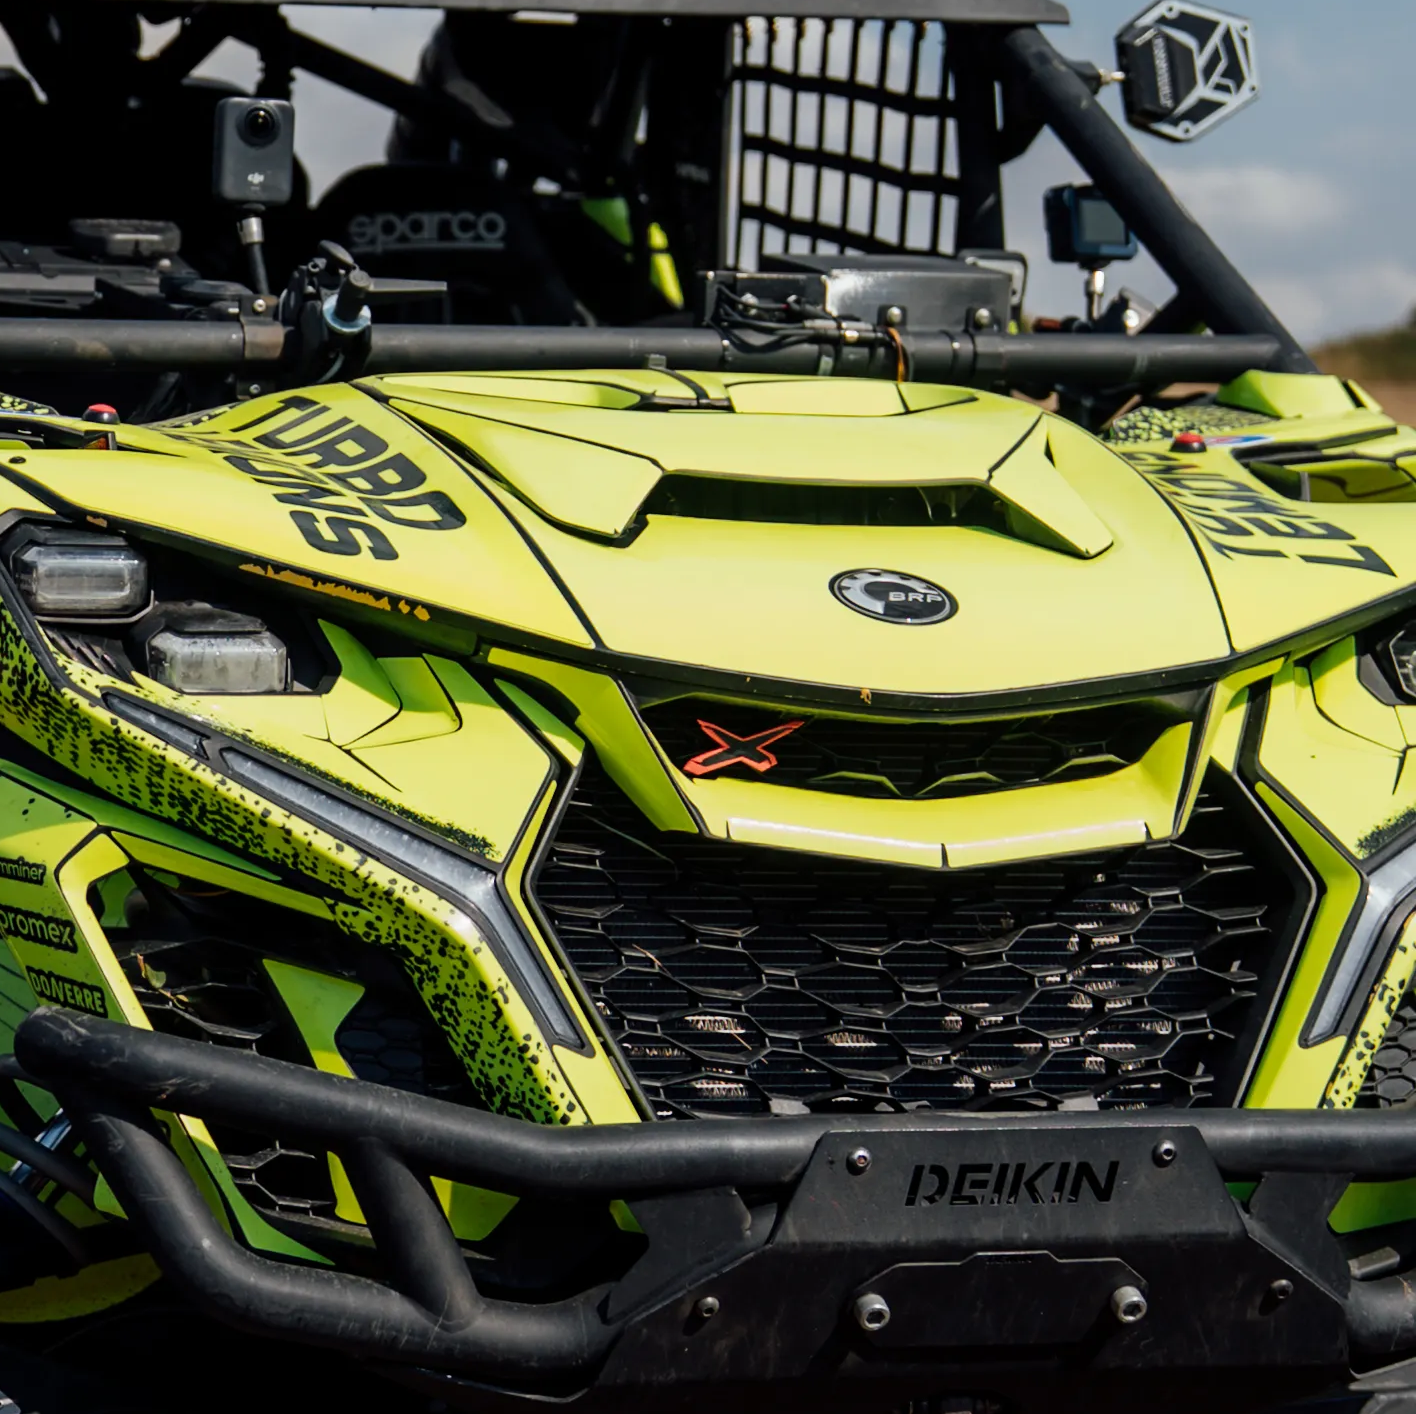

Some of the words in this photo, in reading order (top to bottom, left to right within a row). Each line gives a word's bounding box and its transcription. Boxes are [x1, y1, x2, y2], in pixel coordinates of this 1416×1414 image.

[348, 210, 507, 254] sparco
[229, 395, 467, 531] TURBO
[888, 590, 943, 604] BRP
[28, 971, 106, 1014] DONERRE
[904, 1160, 1121, 1207] DEIKIN
